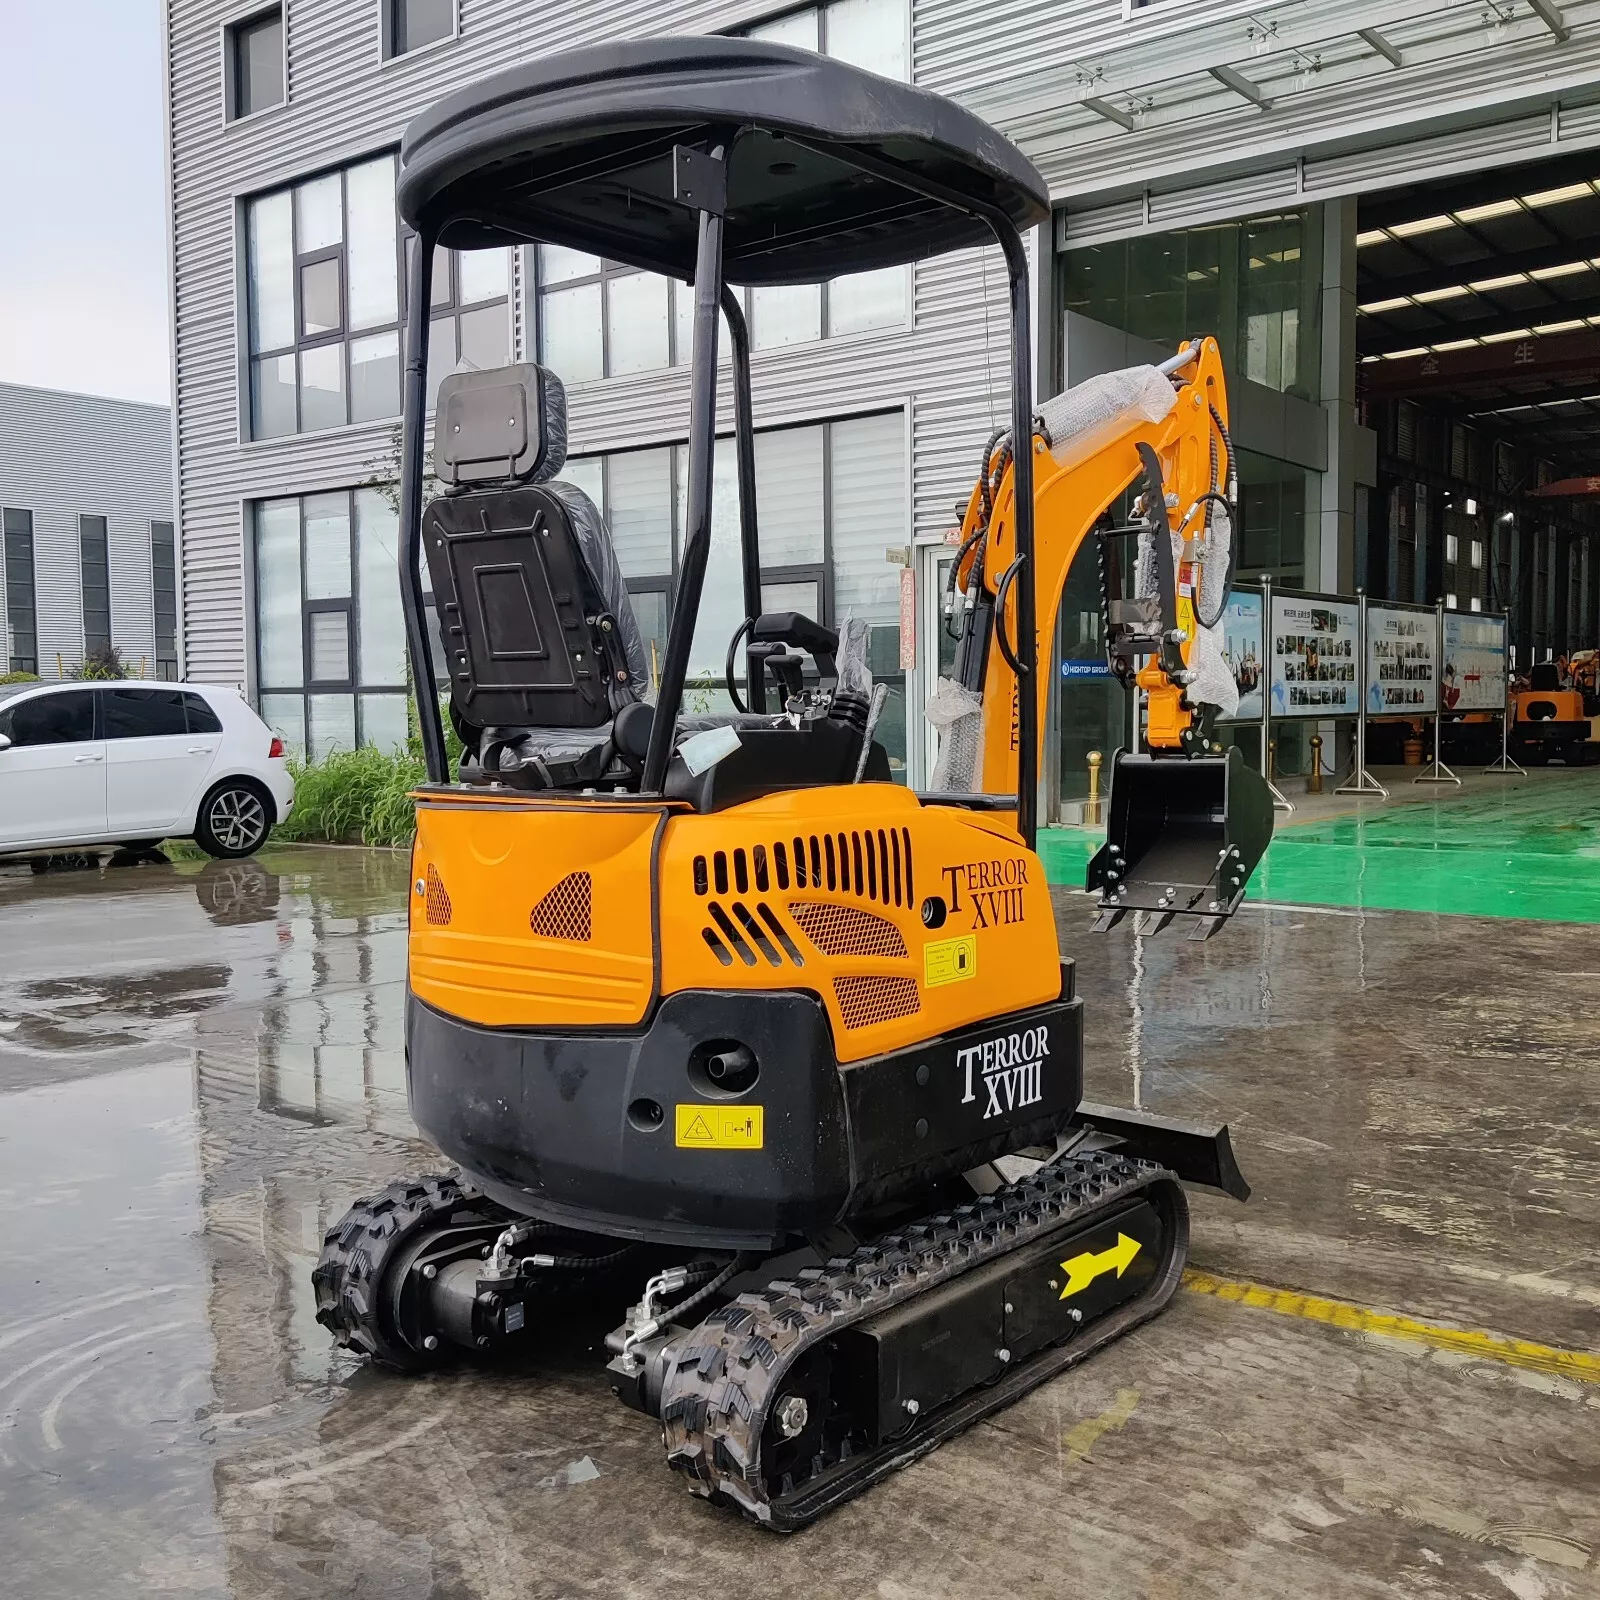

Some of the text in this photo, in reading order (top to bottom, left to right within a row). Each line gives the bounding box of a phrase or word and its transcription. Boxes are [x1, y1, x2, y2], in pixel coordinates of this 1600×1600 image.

[1514, 342, 1536, 365] 生
[1069, 665, 1109, 675] HIGHTOP GROUP
[941, 858, 1029, 914] TERROR
[971, 887, 1025, 930] XVIII
[956, 1025, 1050, 1104] TERROR
[983, 1060, 1043, 1120] XVIII
